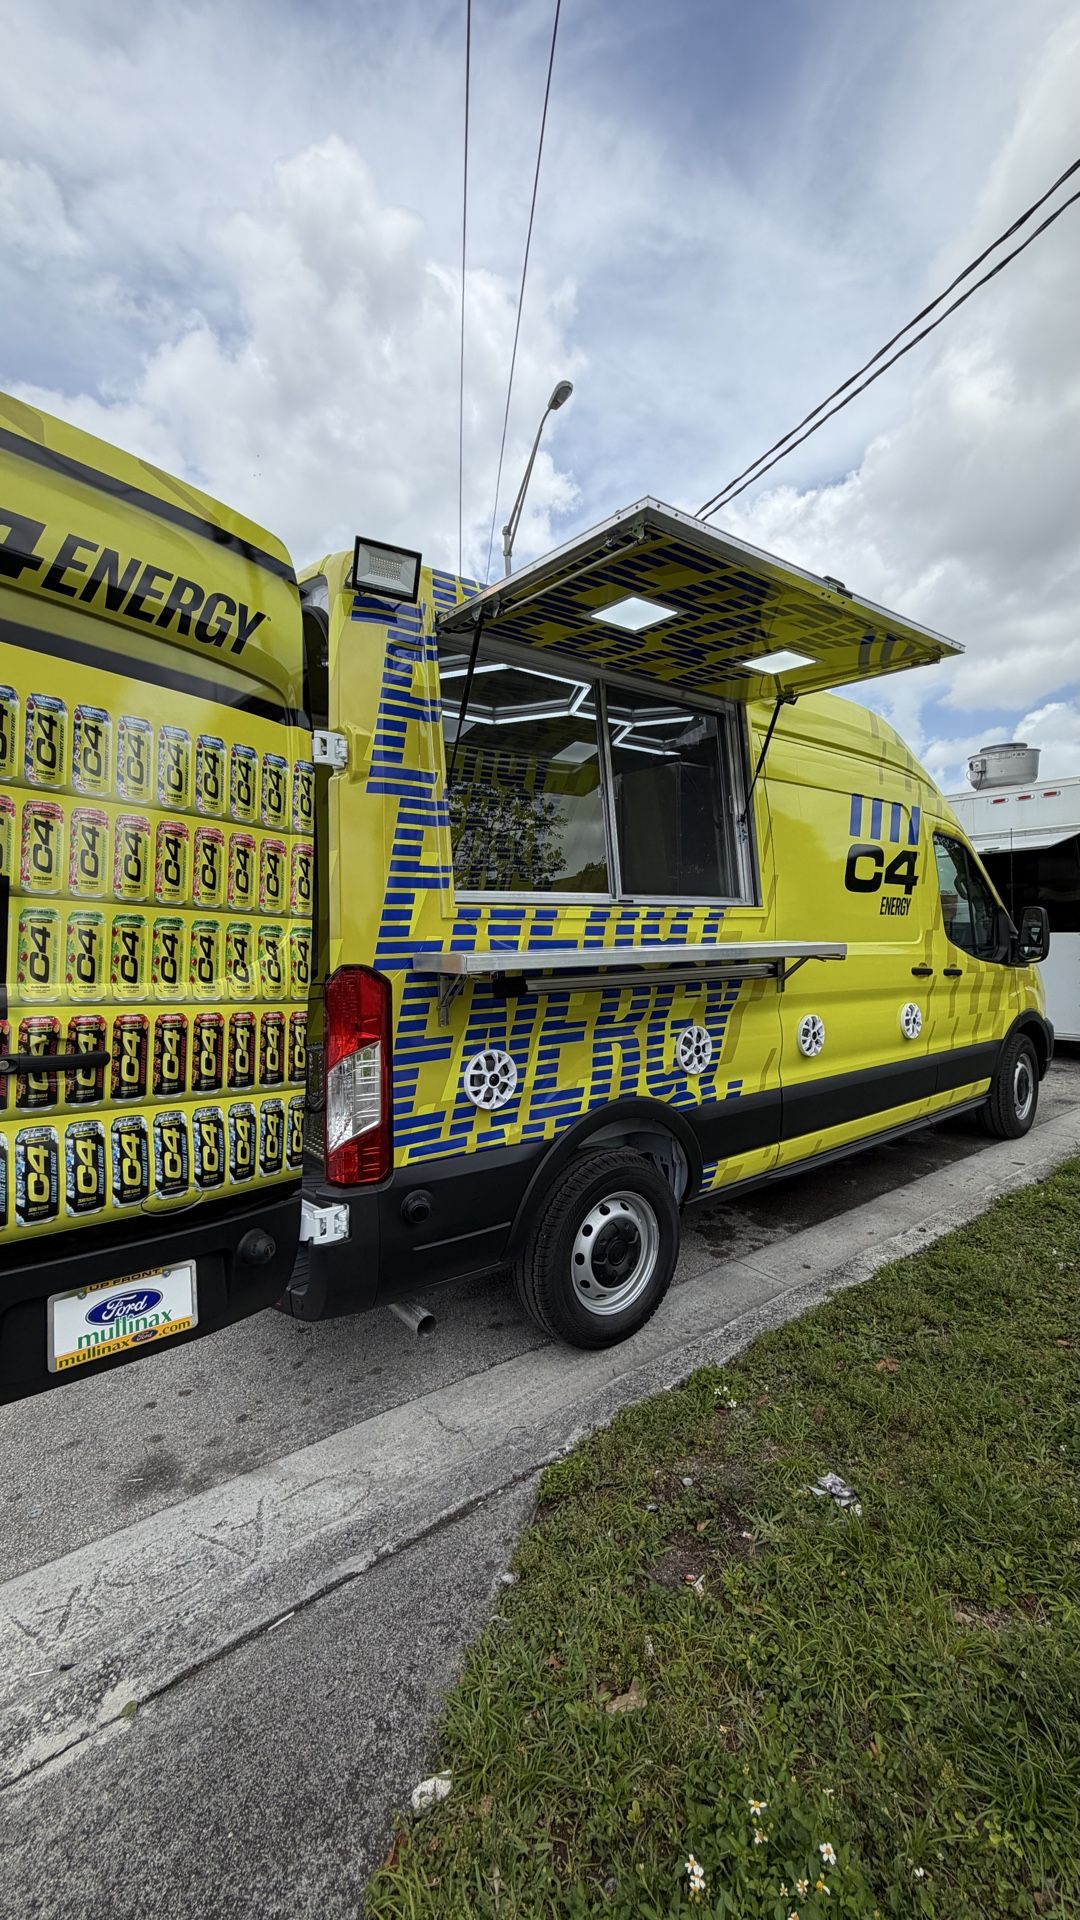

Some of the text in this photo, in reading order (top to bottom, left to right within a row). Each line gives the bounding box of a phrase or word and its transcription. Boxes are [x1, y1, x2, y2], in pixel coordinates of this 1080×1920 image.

[41, 534, 267, 655] ENERGY
[36, 712, 58, 769] C4
[83, 723, 102, 777] C4
[127, 732, 144, 784] C4
[167, 742, 183, 792] C4
[204, 751, 219, 800] C4
[238, 759, 251, 806] C4
[268, 768, 282, 814] C4
[300, 775, 312, 818] C4
[33, 818, 54, 874] C4
[80, 825, 100, 878] C4
[124, 831, 142, 882] C4
[164, 836, 181, 886] C4
[202, 842, 216, 890] C4
[845, 844, 918, 894] C4
[236, 848, 250, 894] C4
[266, 853, 279, 897] C4
[298, 856, 310, 900] C4
[880, 897, 911, 916] ENERGY
[30, 926, 50, 983] C4
[77, 928, 96, 984] C4
[121, 930, 139, 984] C4
[161, 933, 178, 984] C4
[198, 935, 214, 984] C4
[234, 938, 250, 983] C4
[266, 940, 281, 983] C4
[298, 940, 309, 983] C4
[121, 1032, 140, 1083] C4
[162, 1030, 180, 1080] C4
[200, 1028, 216, 1076] C4
[235, 1027, 249, 1074] C4
[266, 1026, 279, 1071] C4
[294, 1025, 306, 1068] C4
[162, 1128, 182, 1178] C4
[201, 1122, 218, 1171] C4
[236, 1118, 250, 1164] C4
[266, 1113, 279, 1158] C4
[292, 1109, 304, 1152] C4
[27, 1145, 49, 1202] C4
[76, 1139, 97, 1194] C4
[121, 1133, 142, 1186] C4
[89, 1269, 160, 1291] UP FRONT
[78, 1309, 173, 1349] mullinax
[102, 1295, 147, 1320] Ford
[58, 1339, 130, 1368] mullinax
